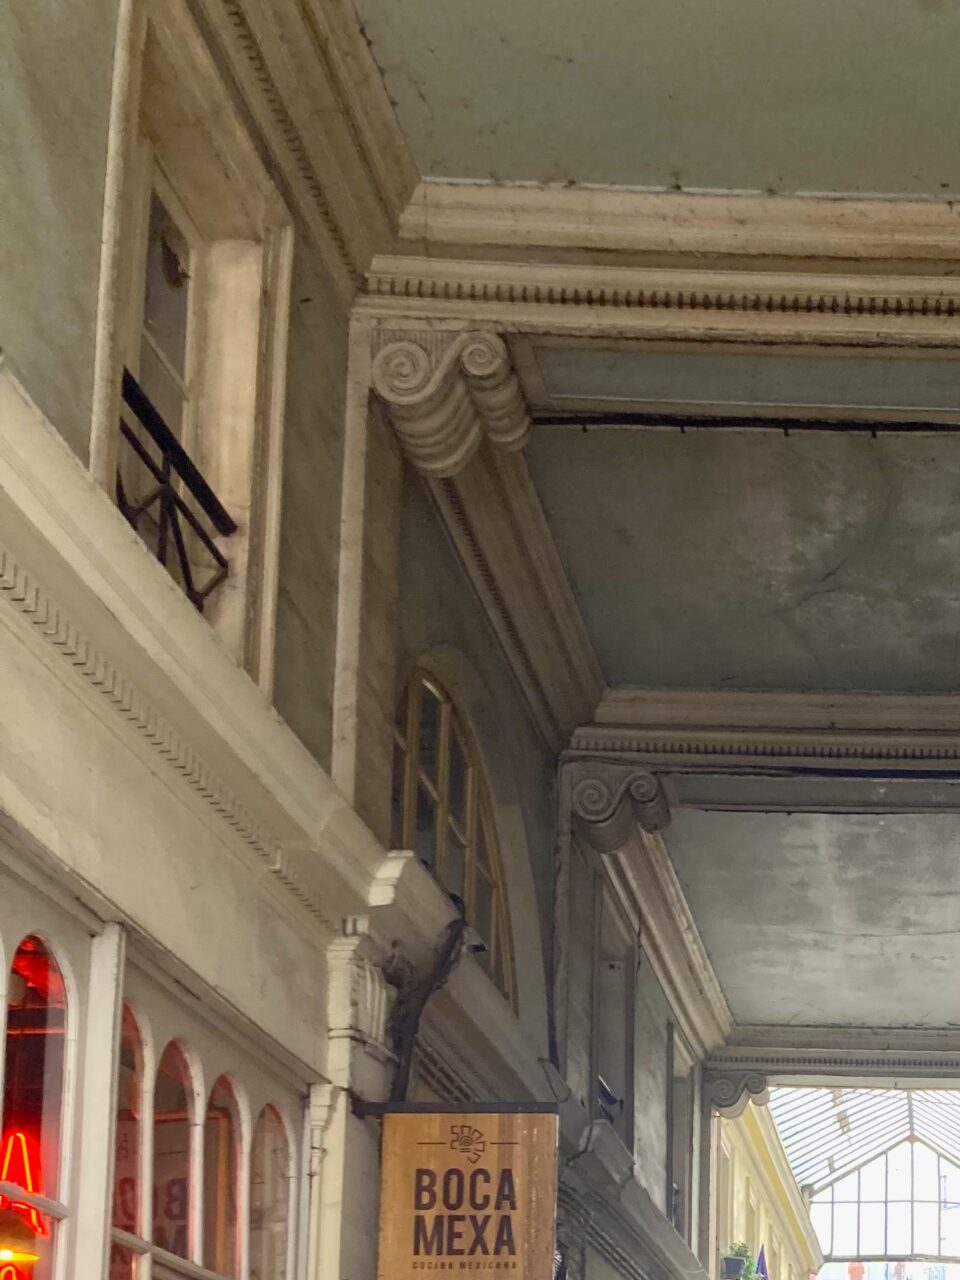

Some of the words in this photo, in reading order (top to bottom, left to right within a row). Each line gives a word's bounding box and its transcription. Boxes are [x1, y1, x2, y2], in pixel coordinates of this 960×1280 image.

[414, 1168, 517, 1211] BOCA
[413, 1214, 516, 1256] MEXA
[412, 1261, 453, 1270] COCINA
[459, 1261, 517, 1270] MEXICANA
